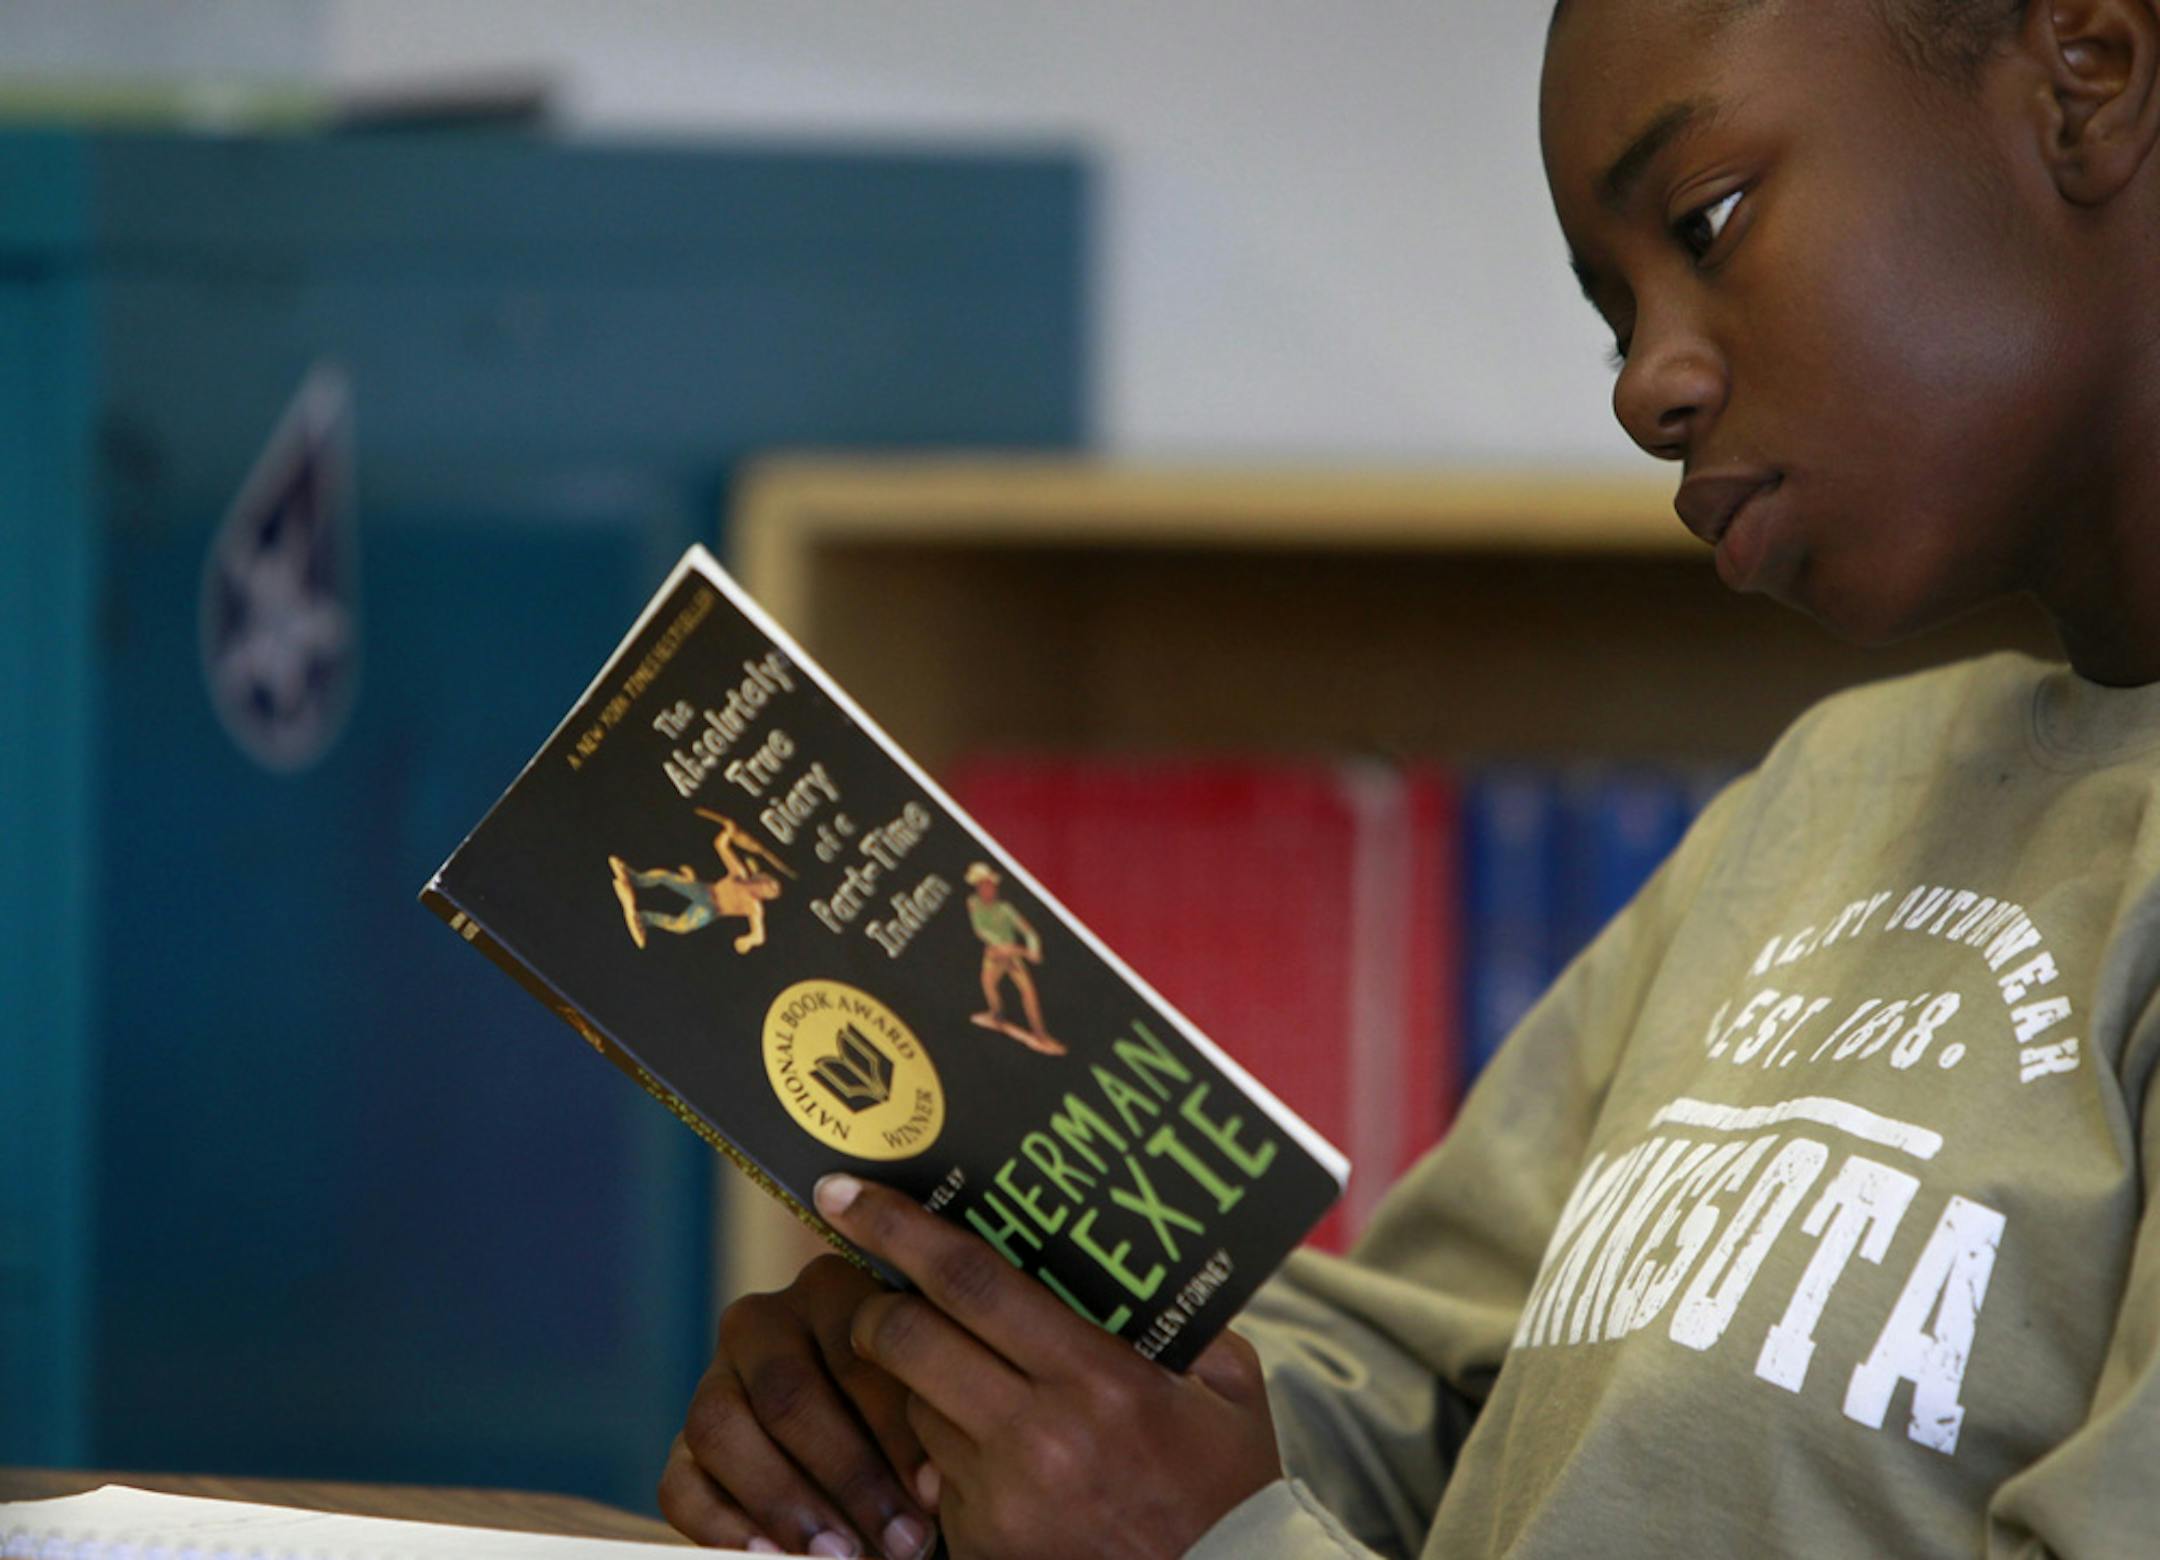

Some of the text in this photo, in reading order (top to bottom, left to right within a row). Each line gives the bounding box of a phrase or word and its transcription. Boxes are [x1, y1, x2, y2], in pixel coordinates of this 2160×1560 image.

[653, 700, 694, 739] The
[663, 651, 796, 798] Absolutely
[724, 729, 794, 796] True
[760, 762, 839, 845] Diary
[809, 801, 931, 934] Part-Time
[815, 824, 842, 863] of
[865, 873, 951, 958] Indian
[776, 991, 916, 1140] NATIONAL BOOK AWARD
[882, 1087, 934, 1148] WINNER
[1133, 1248, 1233, 1361] ELLEN FORNEY
